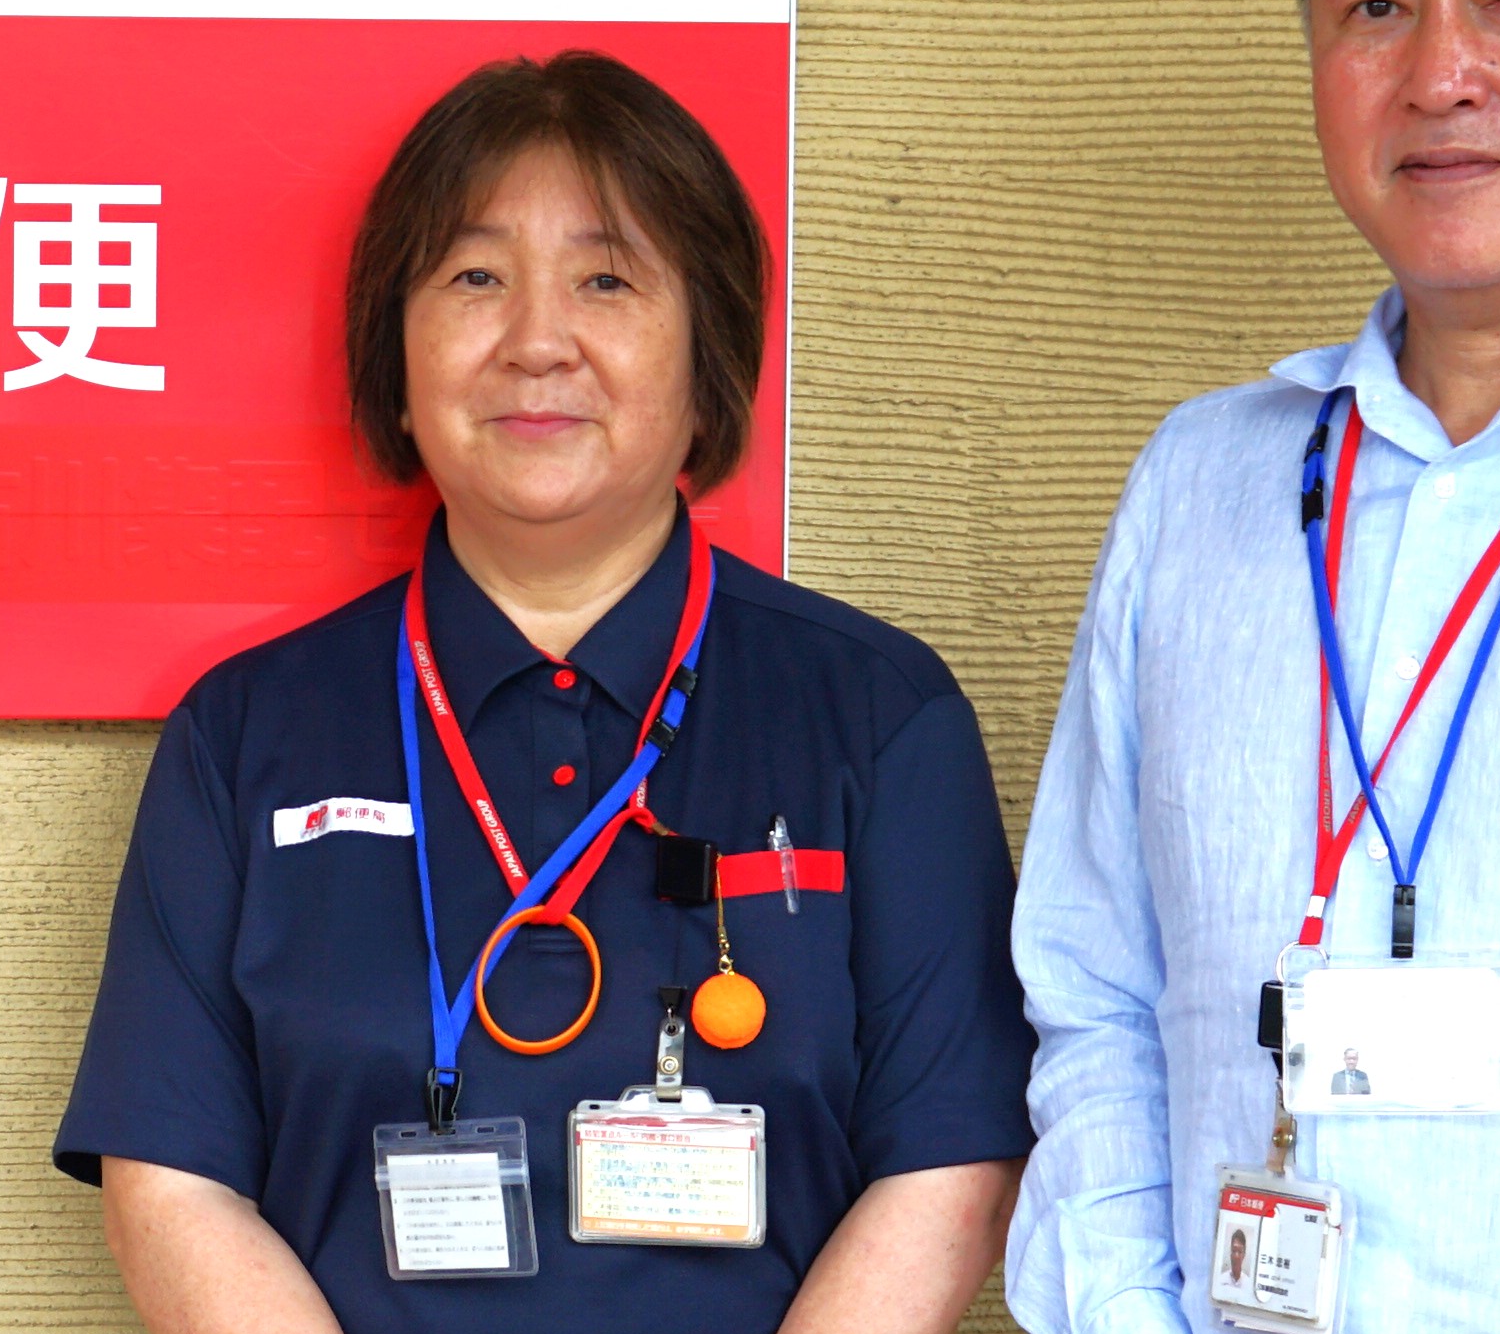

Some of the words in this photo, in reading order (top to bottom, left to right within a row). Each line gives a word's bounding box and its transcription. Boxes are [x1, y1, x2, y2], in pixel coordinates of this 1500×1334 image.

[336, 807, 385, 824] 郵便局
[476, 799, 498, 827] GROUP
[489, 828, 509, 850] POST
[501, 850, 523, 877] JAPAN
